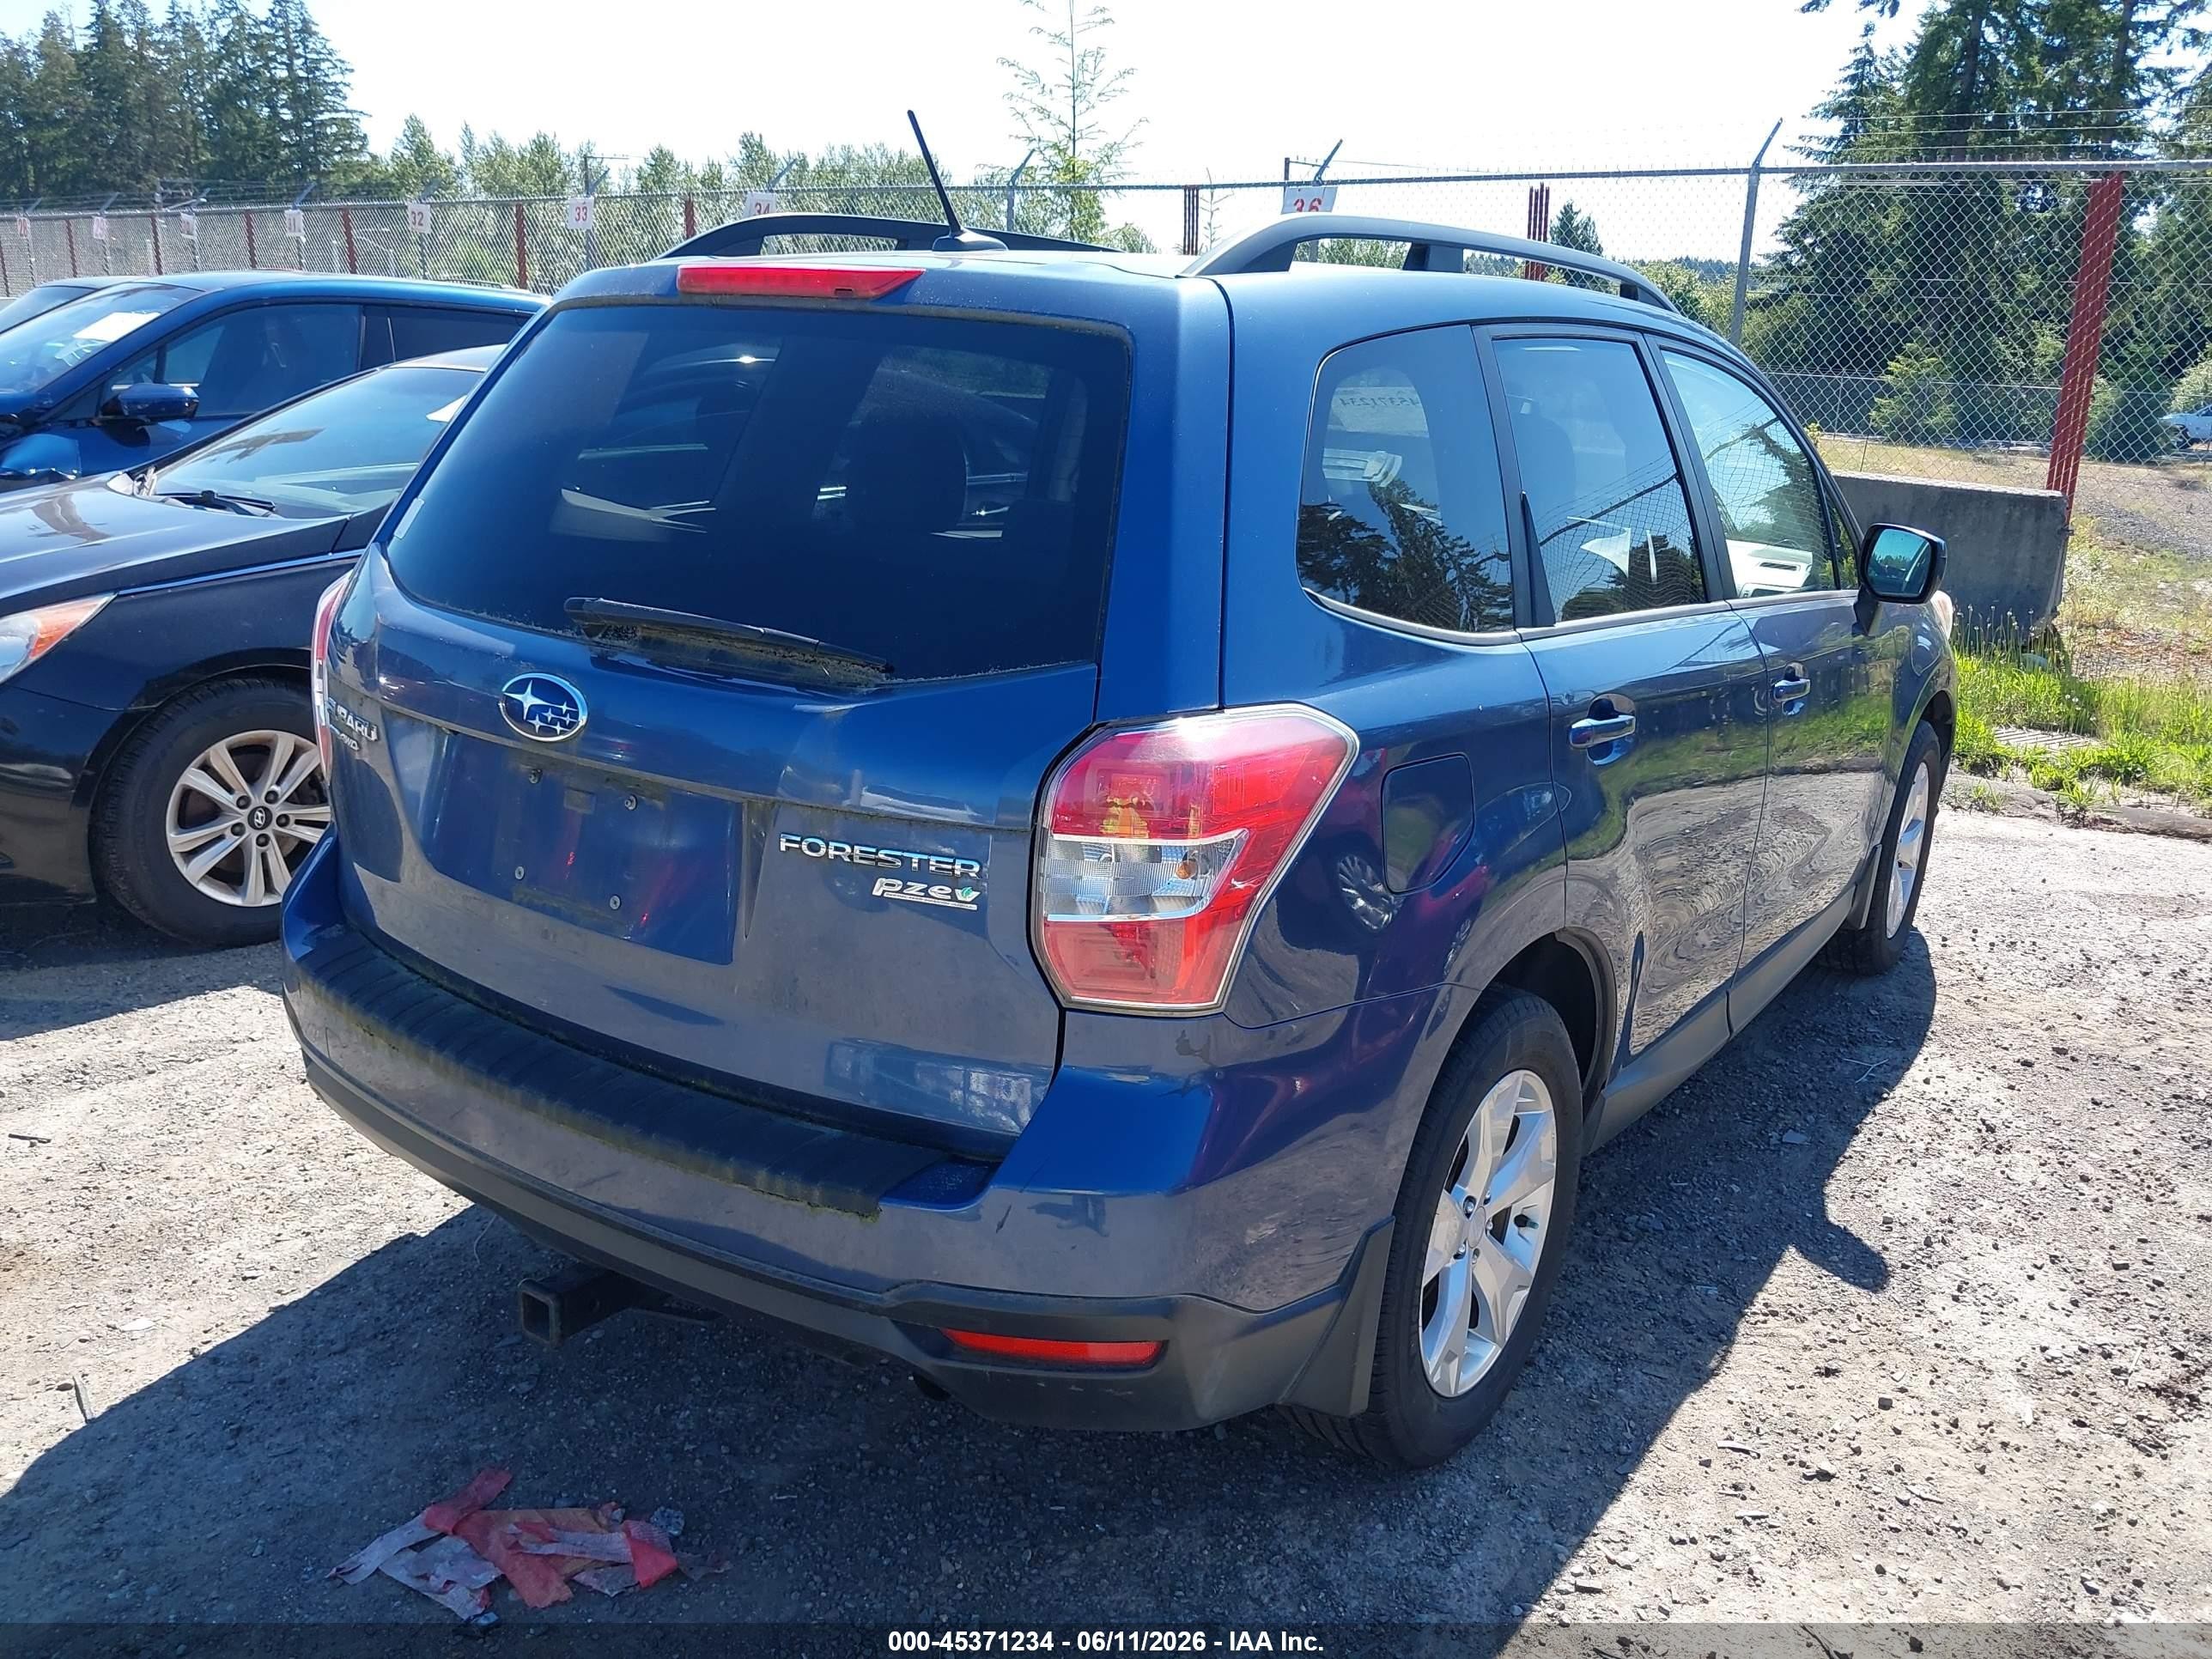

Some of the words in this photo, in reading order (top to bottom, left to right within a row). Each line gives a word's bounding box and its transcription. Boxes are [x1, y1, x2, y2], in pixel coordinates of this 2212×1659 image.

[411, 210, 423, 227] 32
[575, 206, 587, 222] 33
[779, 832, 982, 880] FORESTER
